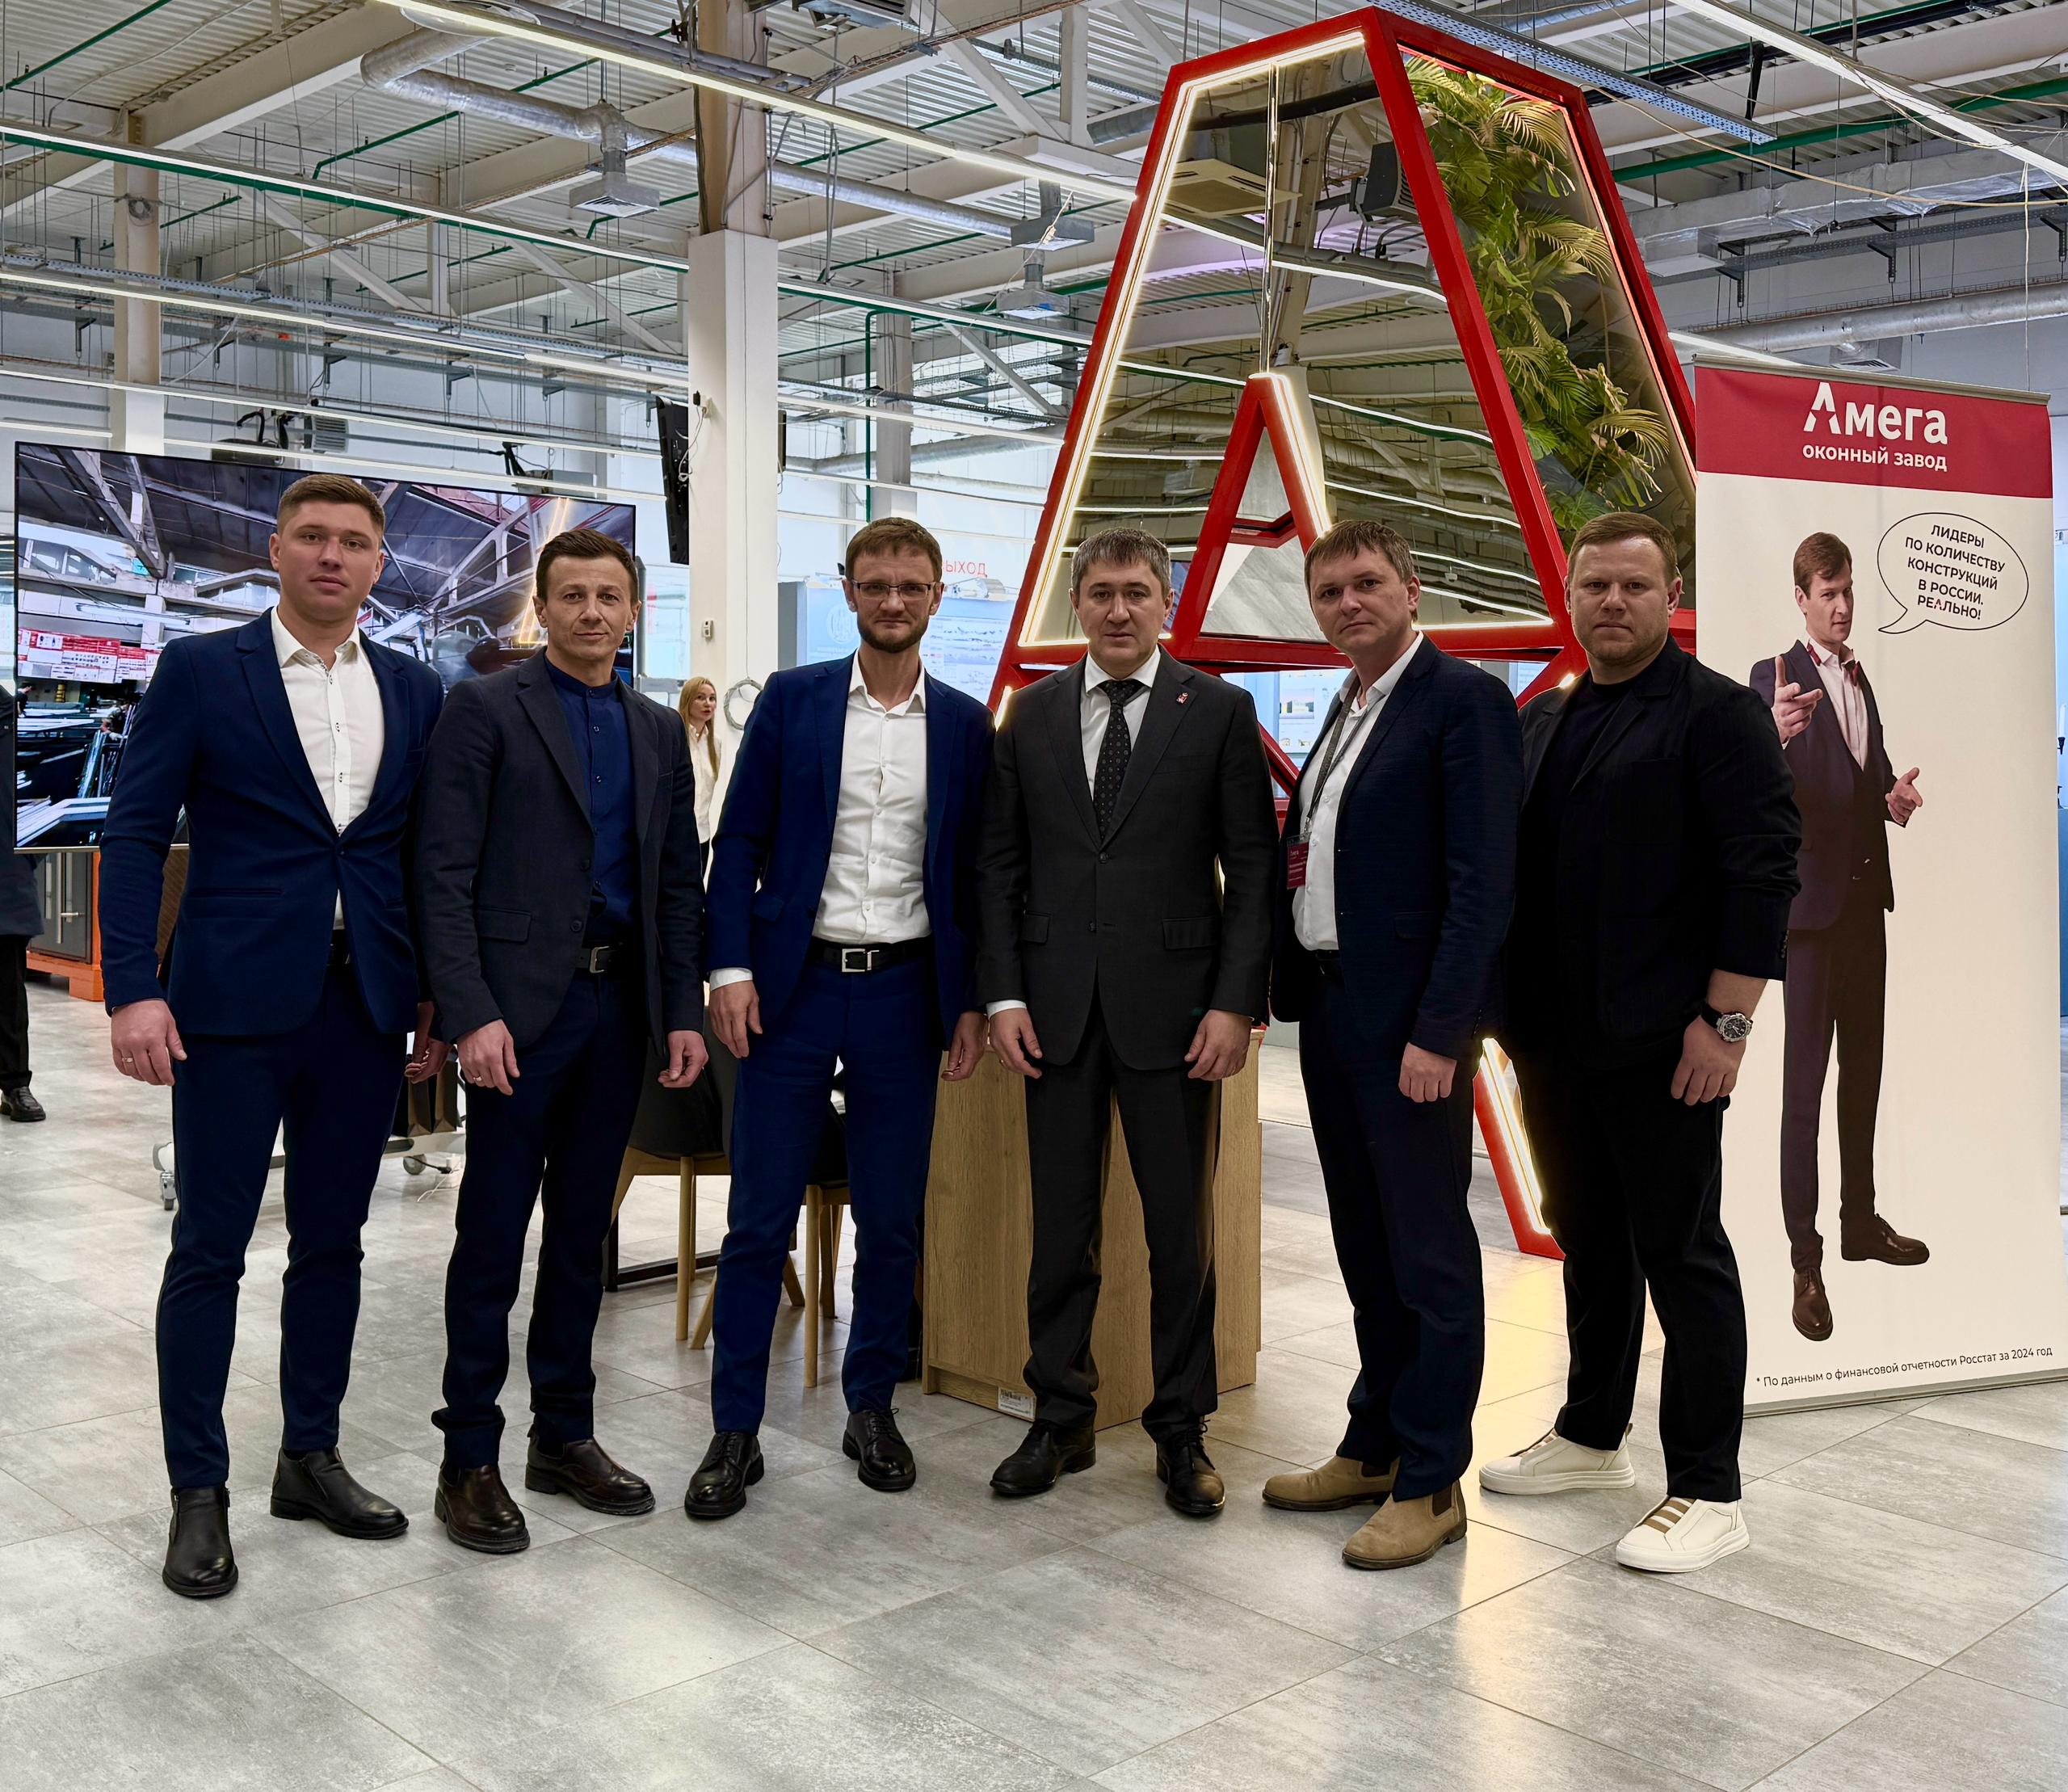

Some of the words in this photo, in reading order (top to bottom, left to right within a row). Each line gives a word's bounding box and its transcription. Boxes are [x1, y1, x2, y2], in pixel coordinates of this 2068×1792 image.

[1803, 381, 1948, 445] Амега
[1802, 444, 1889, 465] оконный
[1894, 452, 1948, 473] завод
[1931, 524, 1985, 549] ЛИДЕРЫ
[942, 560, 988, 578] ЫХОД
[1905, 536, 1923, 551] ПО
[1926, 542, 2006, 573] КОЛИЧЕСТВУ
[1907, 556, 1998, 591] КОНСТРУКЦИЙ
[1918, 578, 1927, 591] В
[1930, 581, 1984, 605] РОССИИ.
[1763, 1376, 1779, 1387] По
[1780, 1373, 1823, 1386] данным
[1826, 1372, 1833, 1380] о
[1835, 1363, 1899, 1381] финансовой
[1901, 1359, 1957, 1372] отчетности
[1959, 1352, 1997, 1365] Росстат
[1999, 1352, 2010, 1361] за
[2011, 1347, 2035, 1360] 2024
[2036, 1347, 2053, 1357] год
